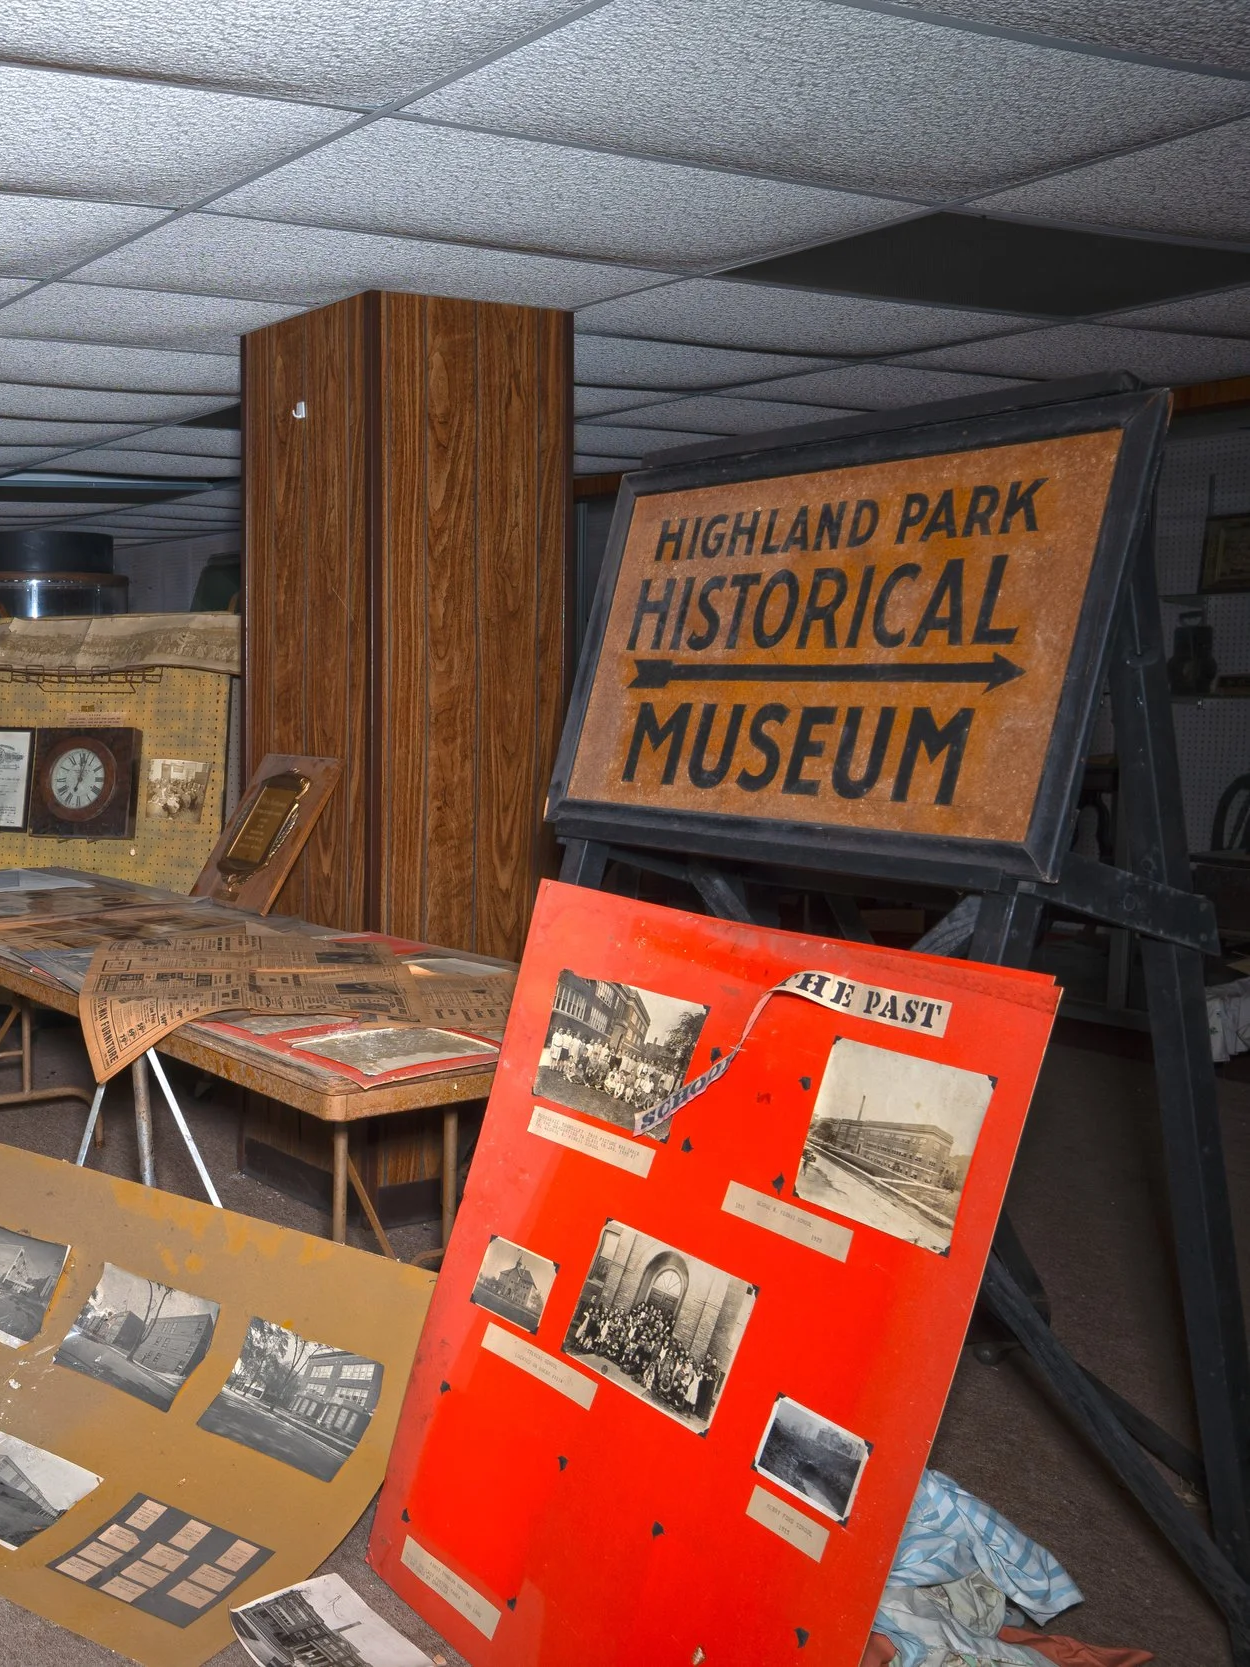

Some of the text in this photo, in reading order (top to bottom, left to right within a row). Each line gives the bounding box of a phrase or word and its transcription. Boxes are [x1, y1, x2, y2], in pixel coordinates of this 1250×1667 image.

[654, 477, 1049, 562] HIGHLAND PARK
[626, 554, 1019, 651] HISTORICAL
[621, 703, 976, 806] MUSEUM
[100, 1021, 119, 1064] FURNITURE
[863, 990, 943, 1028] PAST
